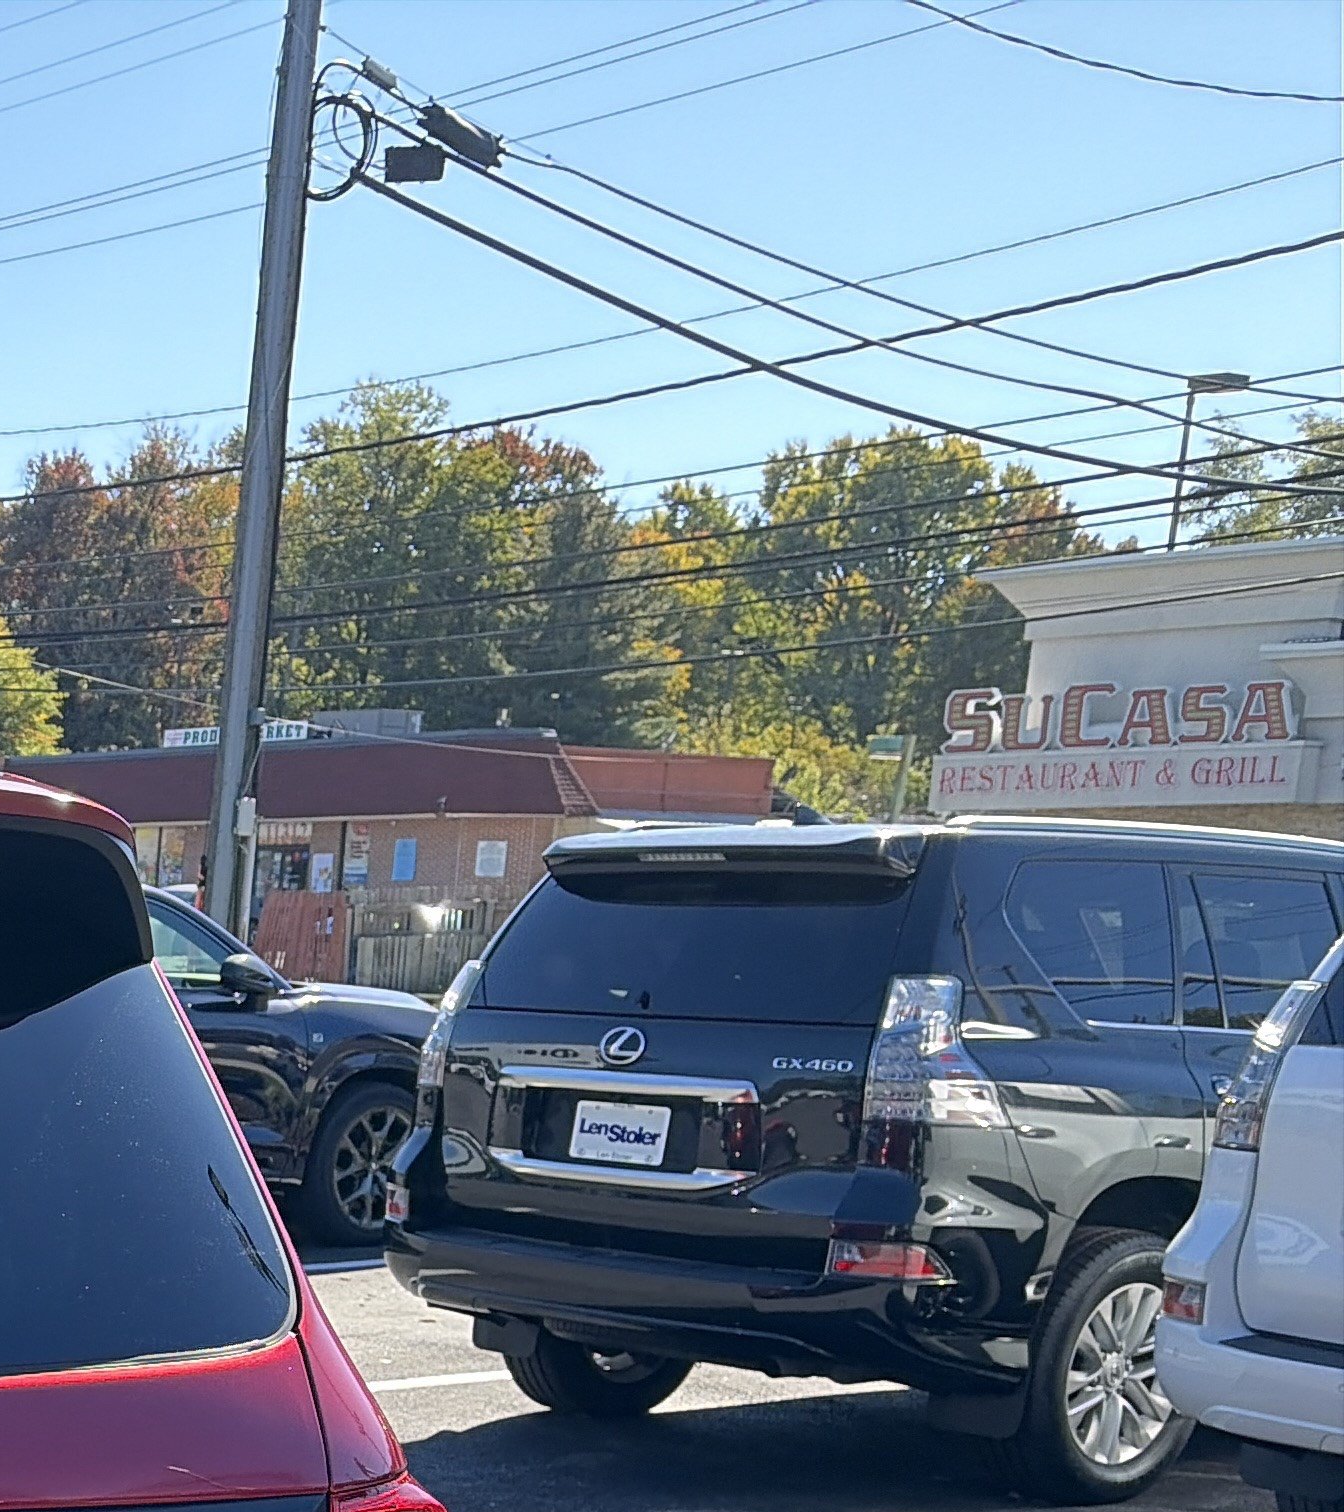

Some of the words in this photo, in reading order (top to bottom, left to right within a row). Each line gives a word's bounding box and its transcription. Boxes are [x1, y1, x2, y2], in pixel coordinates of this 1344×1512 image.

[938, 759, 1147, 795] RESTAURANT
[1155, 758, 1176, 785] &
[1191, 754, 1287, 785] GRILL
